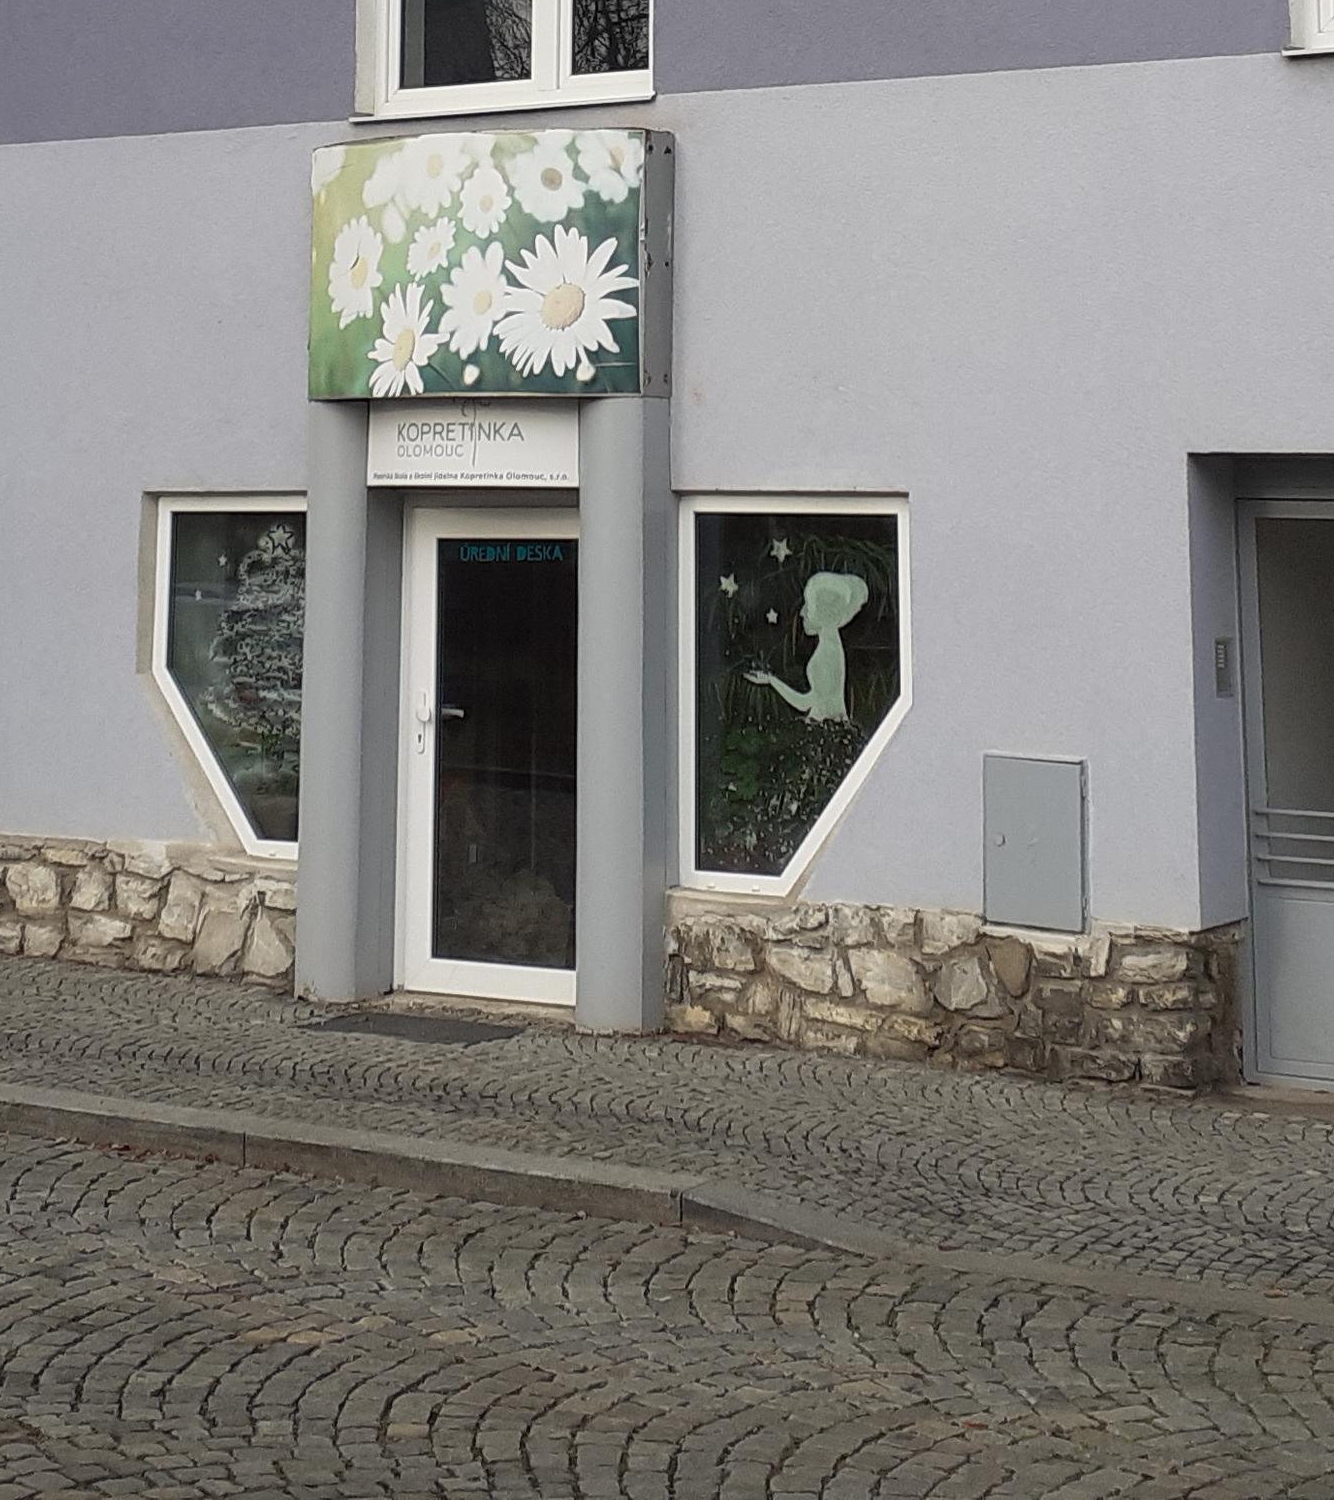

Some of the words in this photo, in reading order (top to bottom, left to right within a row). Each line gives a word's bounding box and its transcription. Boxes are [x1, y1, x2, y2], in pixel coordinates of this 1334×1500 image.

[397, 421, 525, 443] KOPRETINKA
[397, 444, 465, 458] OLOMOUC
[516, 545, 564, 561] DESKA
